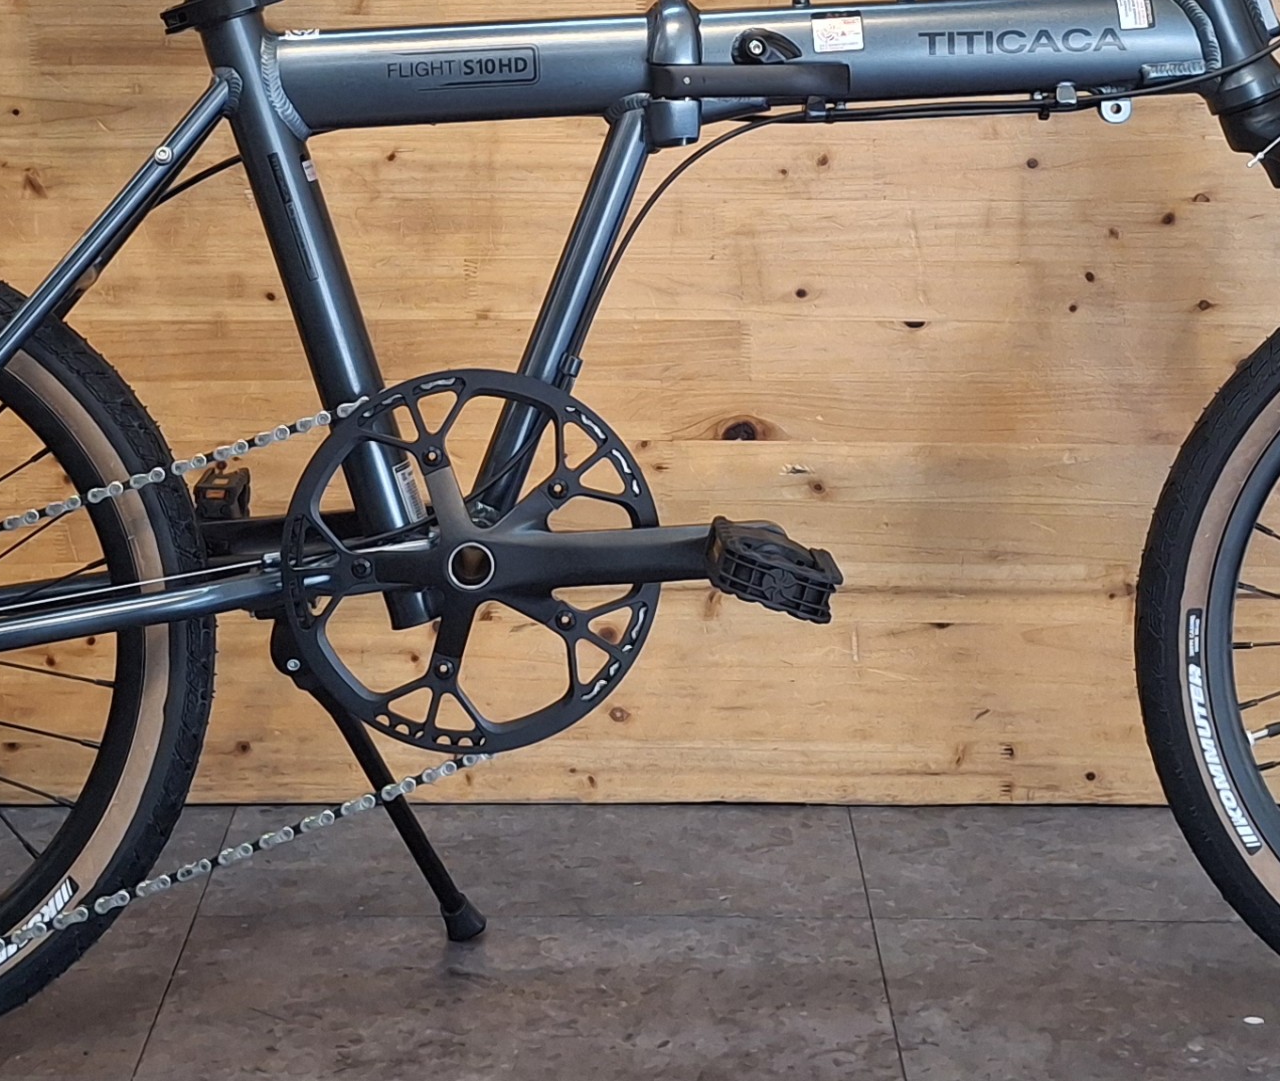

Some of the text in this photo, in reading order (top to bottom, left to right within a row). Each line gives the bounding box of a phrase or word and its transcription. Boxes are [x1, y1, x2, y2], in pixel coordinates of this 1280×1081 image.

[918, 27, 1127, 56] TITICACA
[387, 60, 456, 79] FLIGHT
[1188, 663, 1249, 828] KOMMUTER
